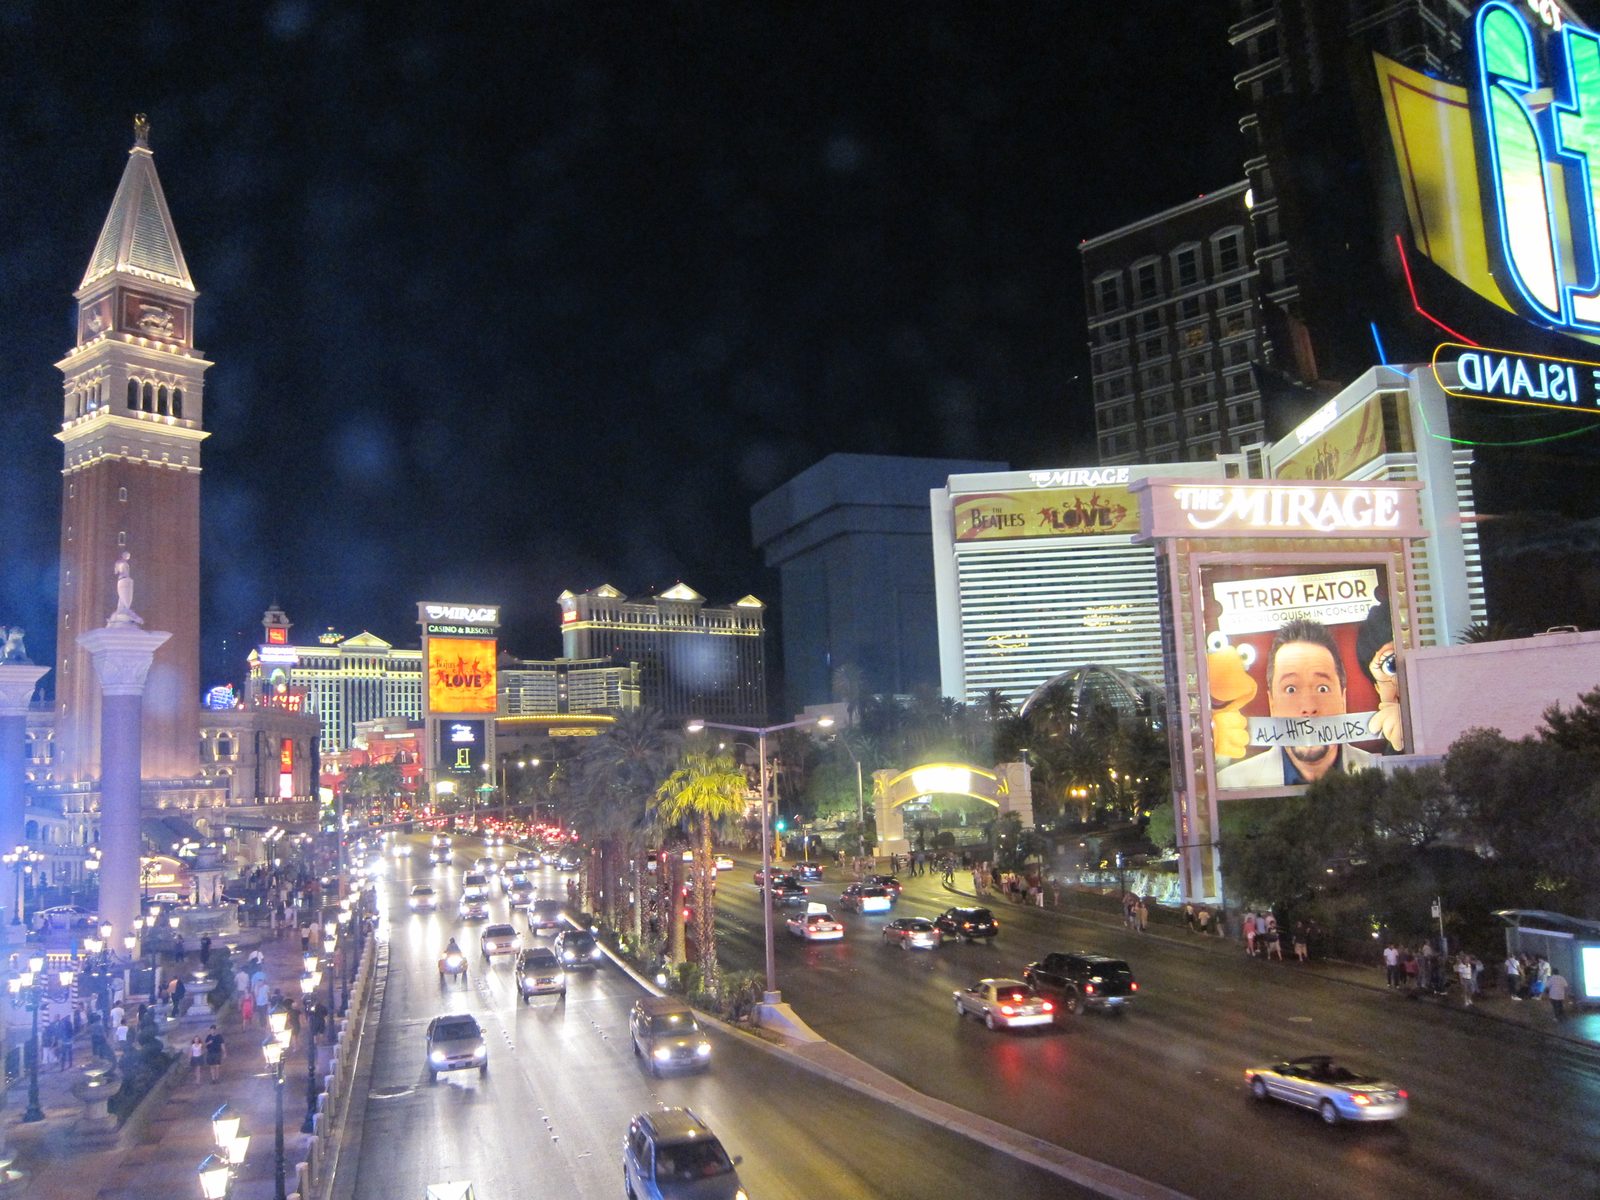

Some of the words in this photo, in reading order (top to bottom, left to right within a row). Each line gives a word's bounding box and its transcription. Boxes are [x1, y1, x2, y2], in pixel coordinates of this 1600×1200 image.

[1036, 467, 1130, 487] MIRAGE
[1174, 487, 1224, 510] THE
[1187, 487, 1400, 532] MIRAGE
[970, 508, 1026, 530] BEATLES
[1051, 507, 1113, 529] LOVE
[1227, 585, 1296, 610] TERRY
[1302, 579, 1368, 604] FATOR
[430, 606, 497, 622] MIRAGE
[1313, 608, 1324, 618] IN
[1326, 603, 1372, 617] CONCERT
[428, 625, 457, 634] CASINO
[465, 627, 495, 636] RESORT
[445, 673, 482, 688] LOVE
[1256, 726, 1284, 743] ALL
[1317, 725, 1333, 743] NO
[1334, 720, 1368, 741] LIPS.
